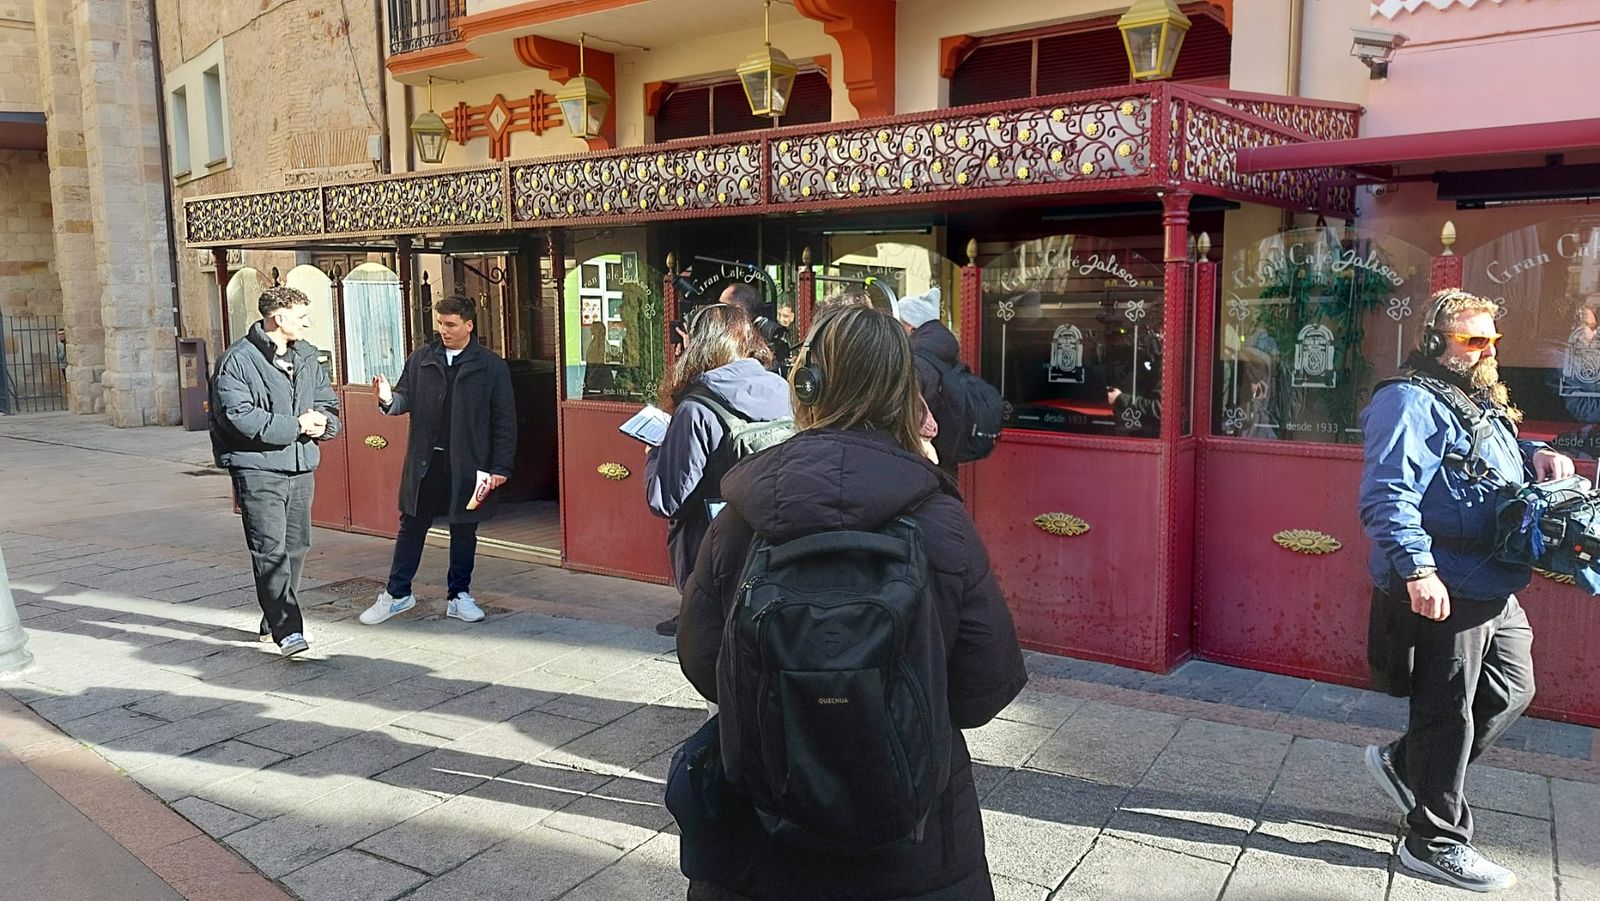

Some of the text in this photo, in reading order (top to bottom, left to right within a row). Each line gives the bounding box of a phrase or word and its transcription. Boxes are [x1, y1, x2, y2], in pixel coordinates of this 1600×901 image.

[1045, 246, 1080, 271] Café
[1079, 254, 1140, 288] Jalisco
[1289, 242, 1333, 266] Café
[1332, 249, 1405, 287] Jalisco
[1486, 252, 1551, 284] Gran
[692, 273, 720, 296] Gran
[721, 260, 745, 280] Café
[1043, 413, 1065, 424] desde
[1286, 421, 1339, 433] desde 1933
[1551, 434, 1585, 447] desde
[818, 697, 849, 705] QUECHUA
